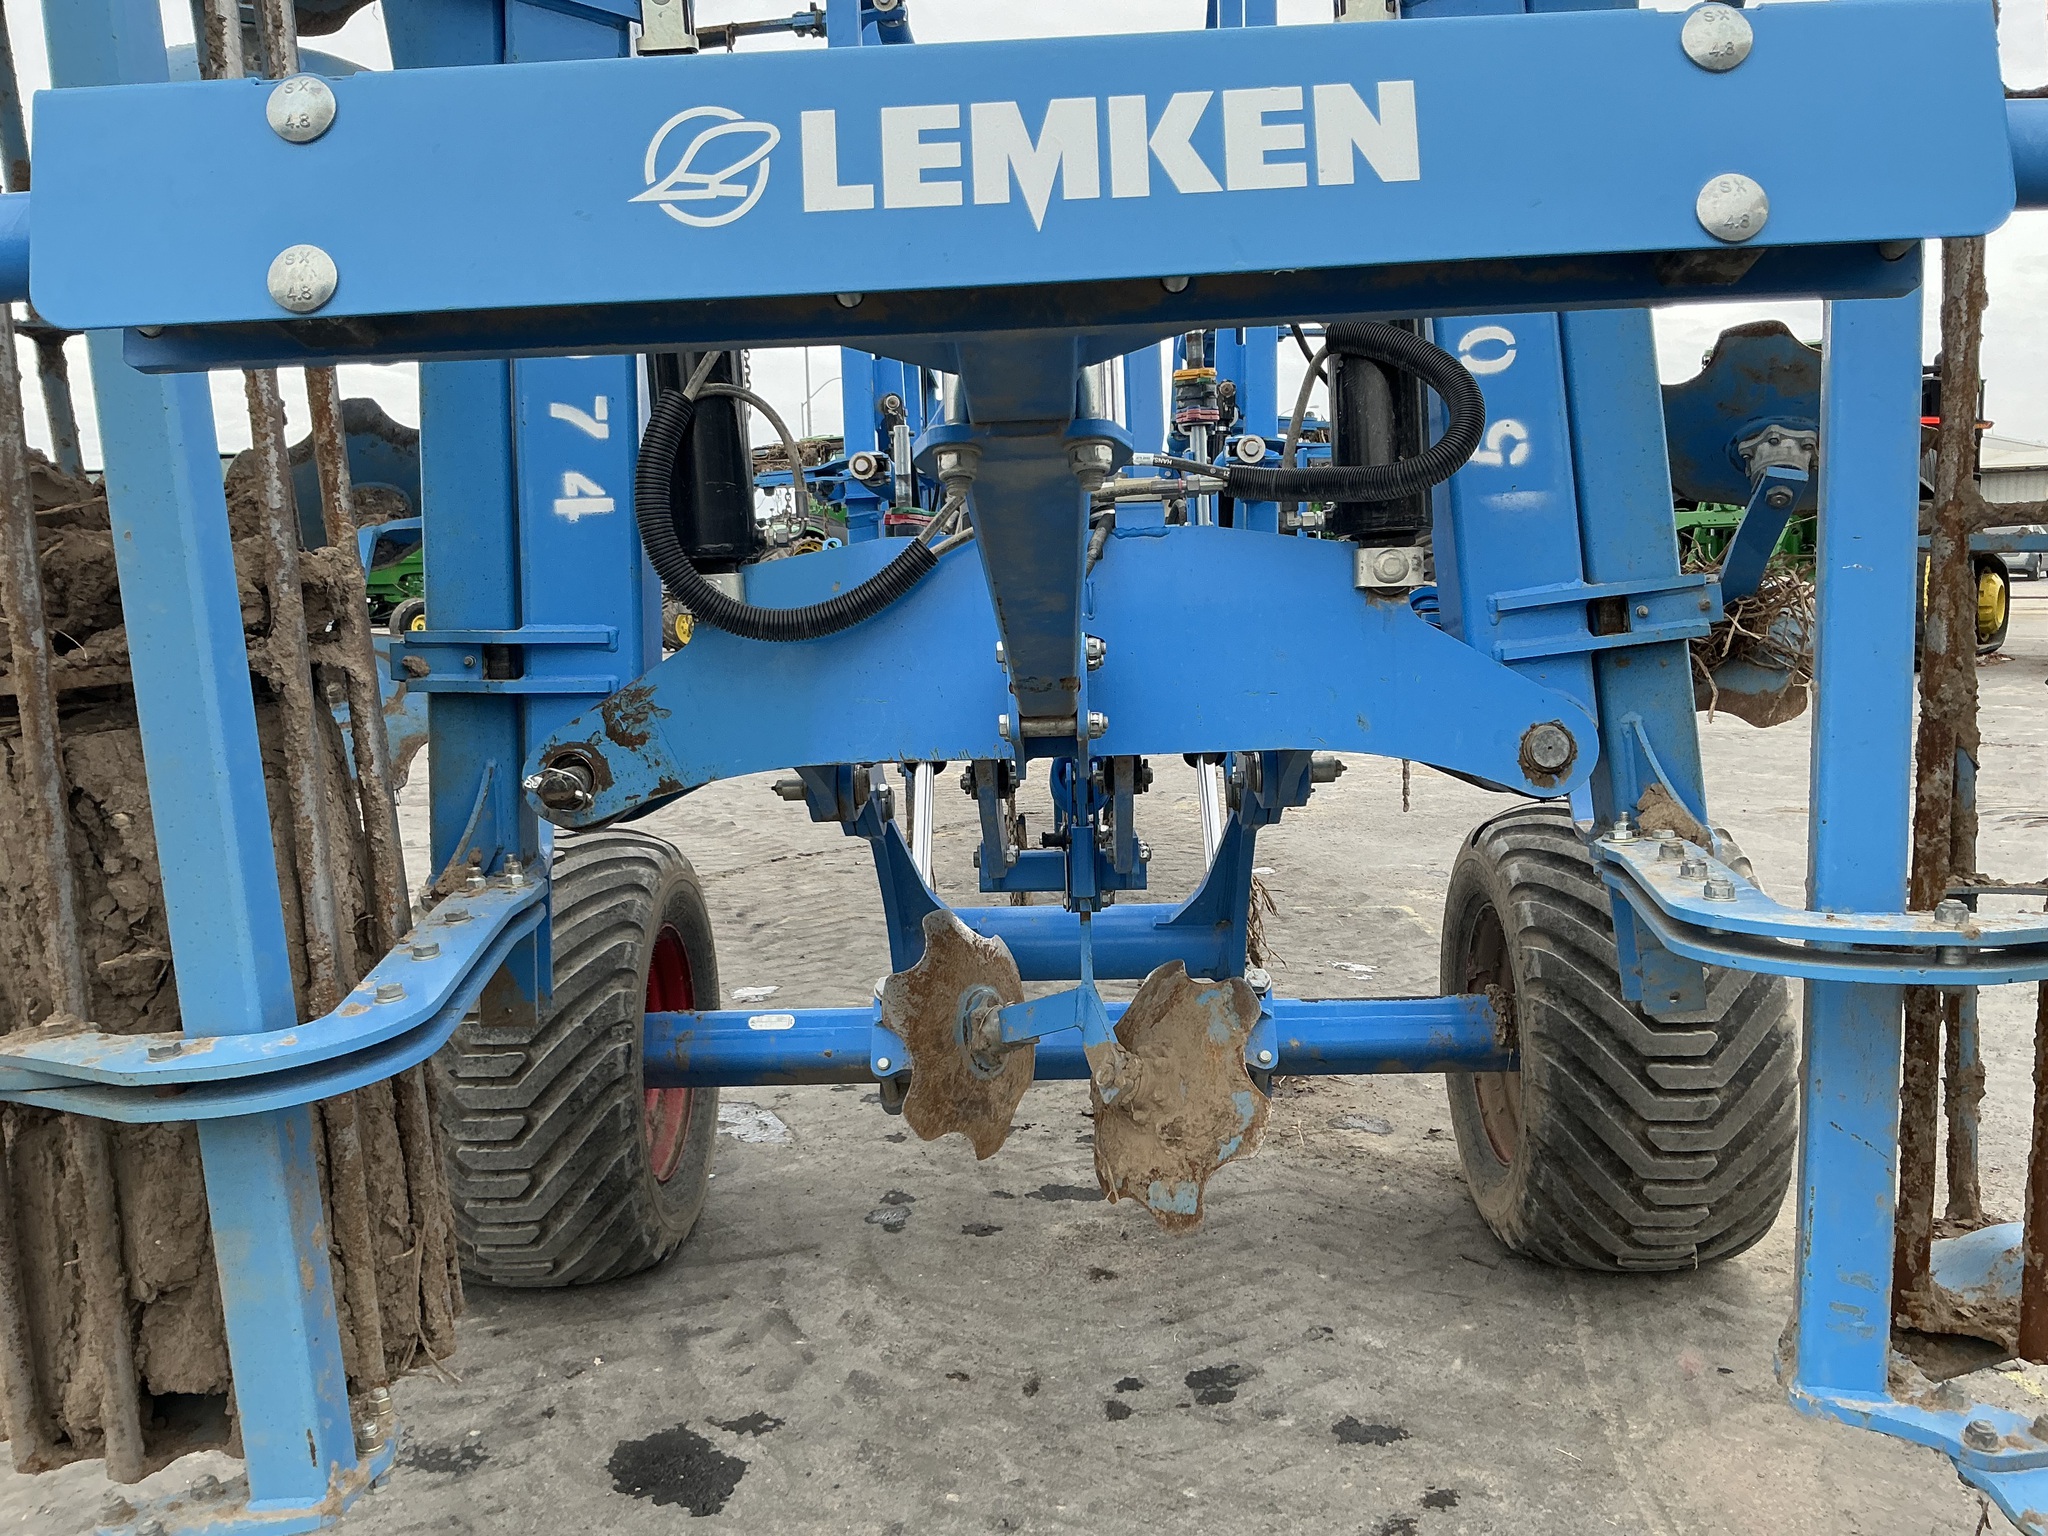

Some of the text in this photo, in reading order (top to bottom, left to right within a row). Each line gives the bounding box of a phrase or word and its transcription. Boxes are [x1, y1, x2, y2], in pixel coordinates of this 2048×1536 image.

[1708, 42, 1736, 58] 4.8
[284, 81, 309, 94] SX
[285, 113, 311, 129] 4.8
[799, 80, 1421, 232] LEMKEN
[1724, 214, 1750, 230] 4.8
[284, 251, 311, 265] SX
[286, 285, 313, 301] 4.8
[549, 356, 616, 522] 74
[1152, 457, 1173, 466] HANS
